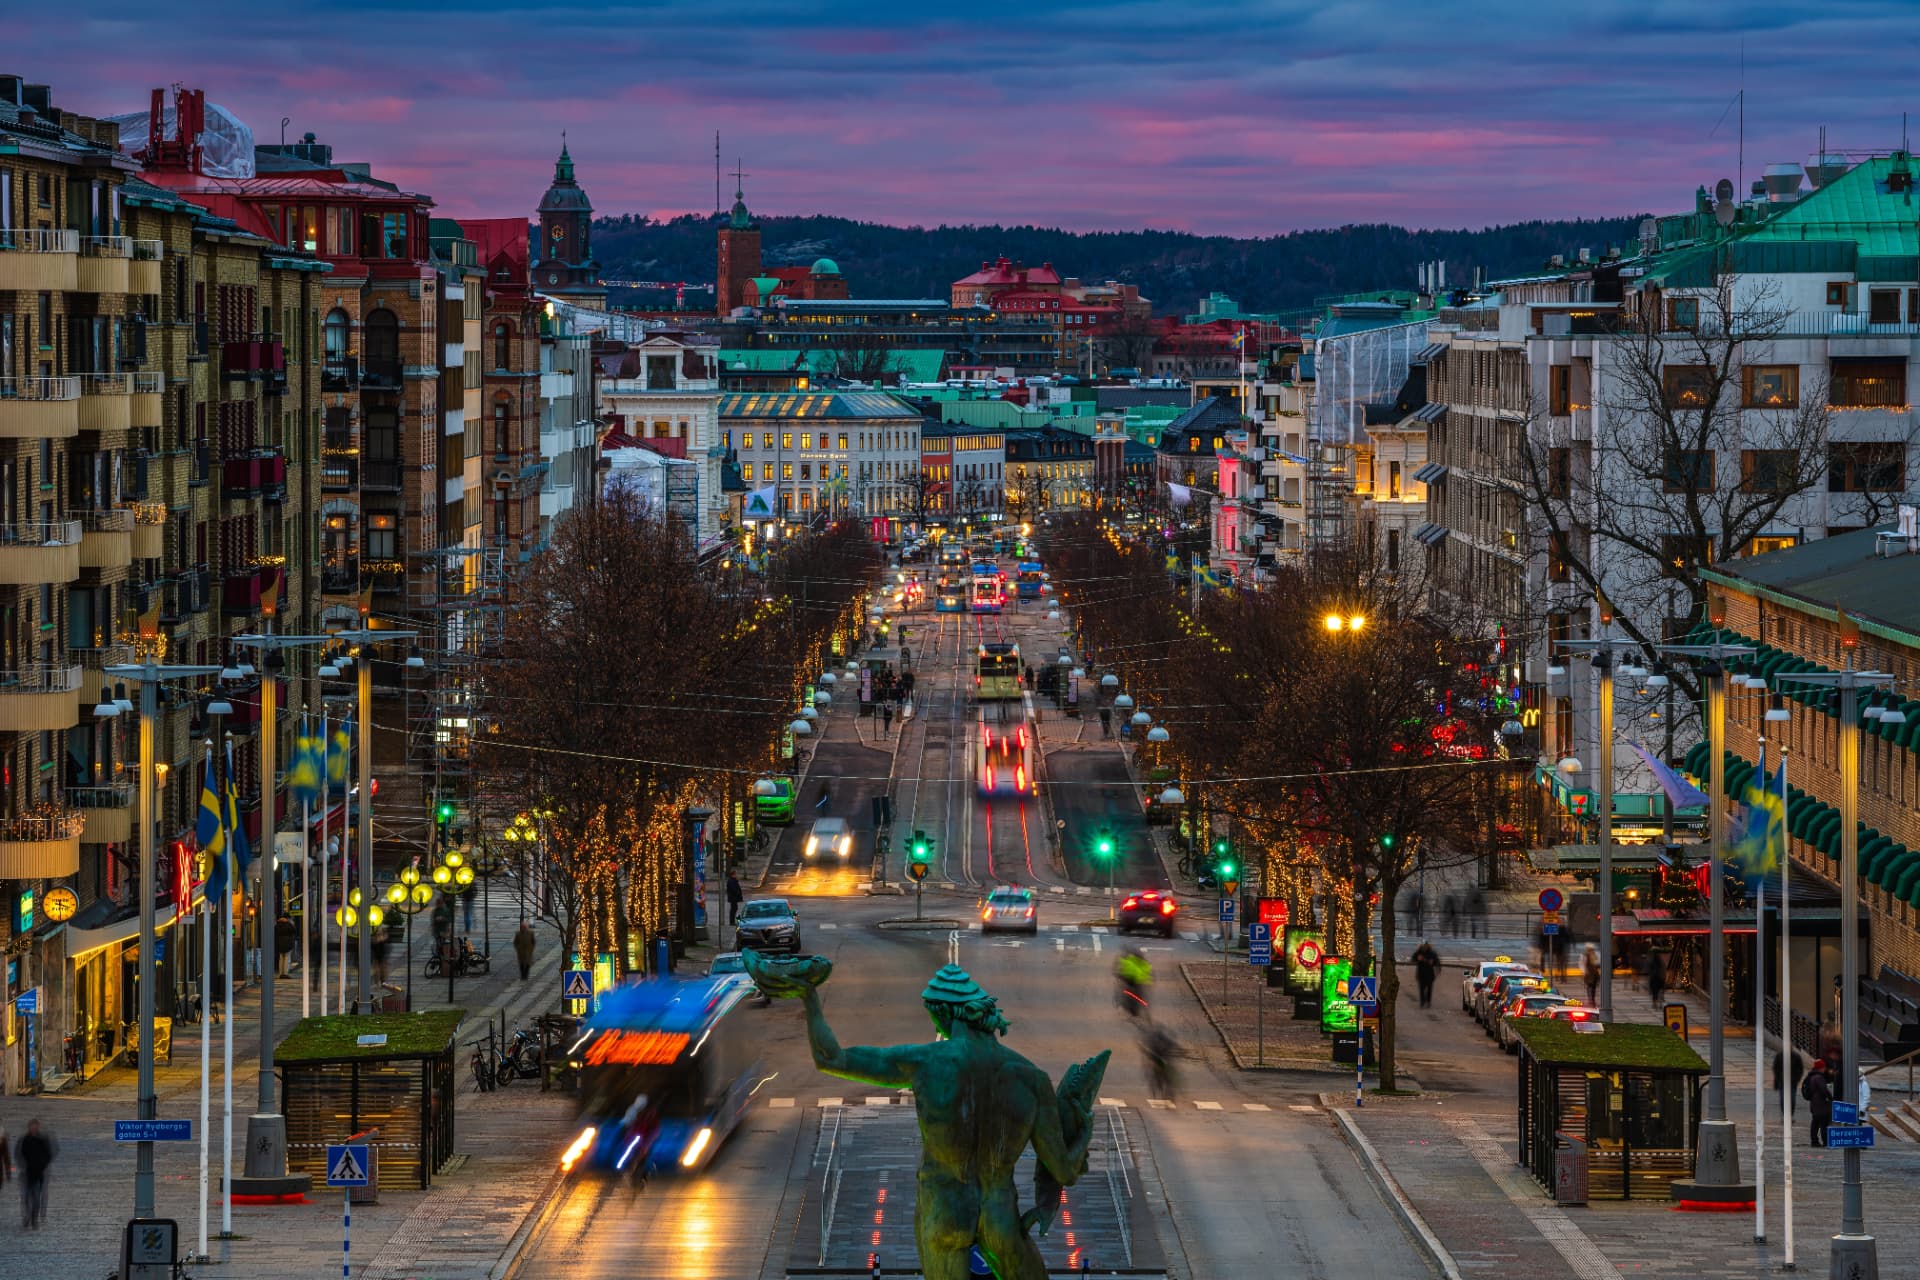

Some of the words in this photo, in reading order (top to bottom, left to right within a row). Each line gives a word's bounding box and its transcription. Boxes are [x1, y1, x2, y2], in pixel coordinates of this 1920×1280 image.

[1223, 900, 1233, 913] P
[1255, 925, 1266, 940] P
[119, 1122, 142, 1130] Viktor
[145, 1122, 188, 1131] Rydbergs-
